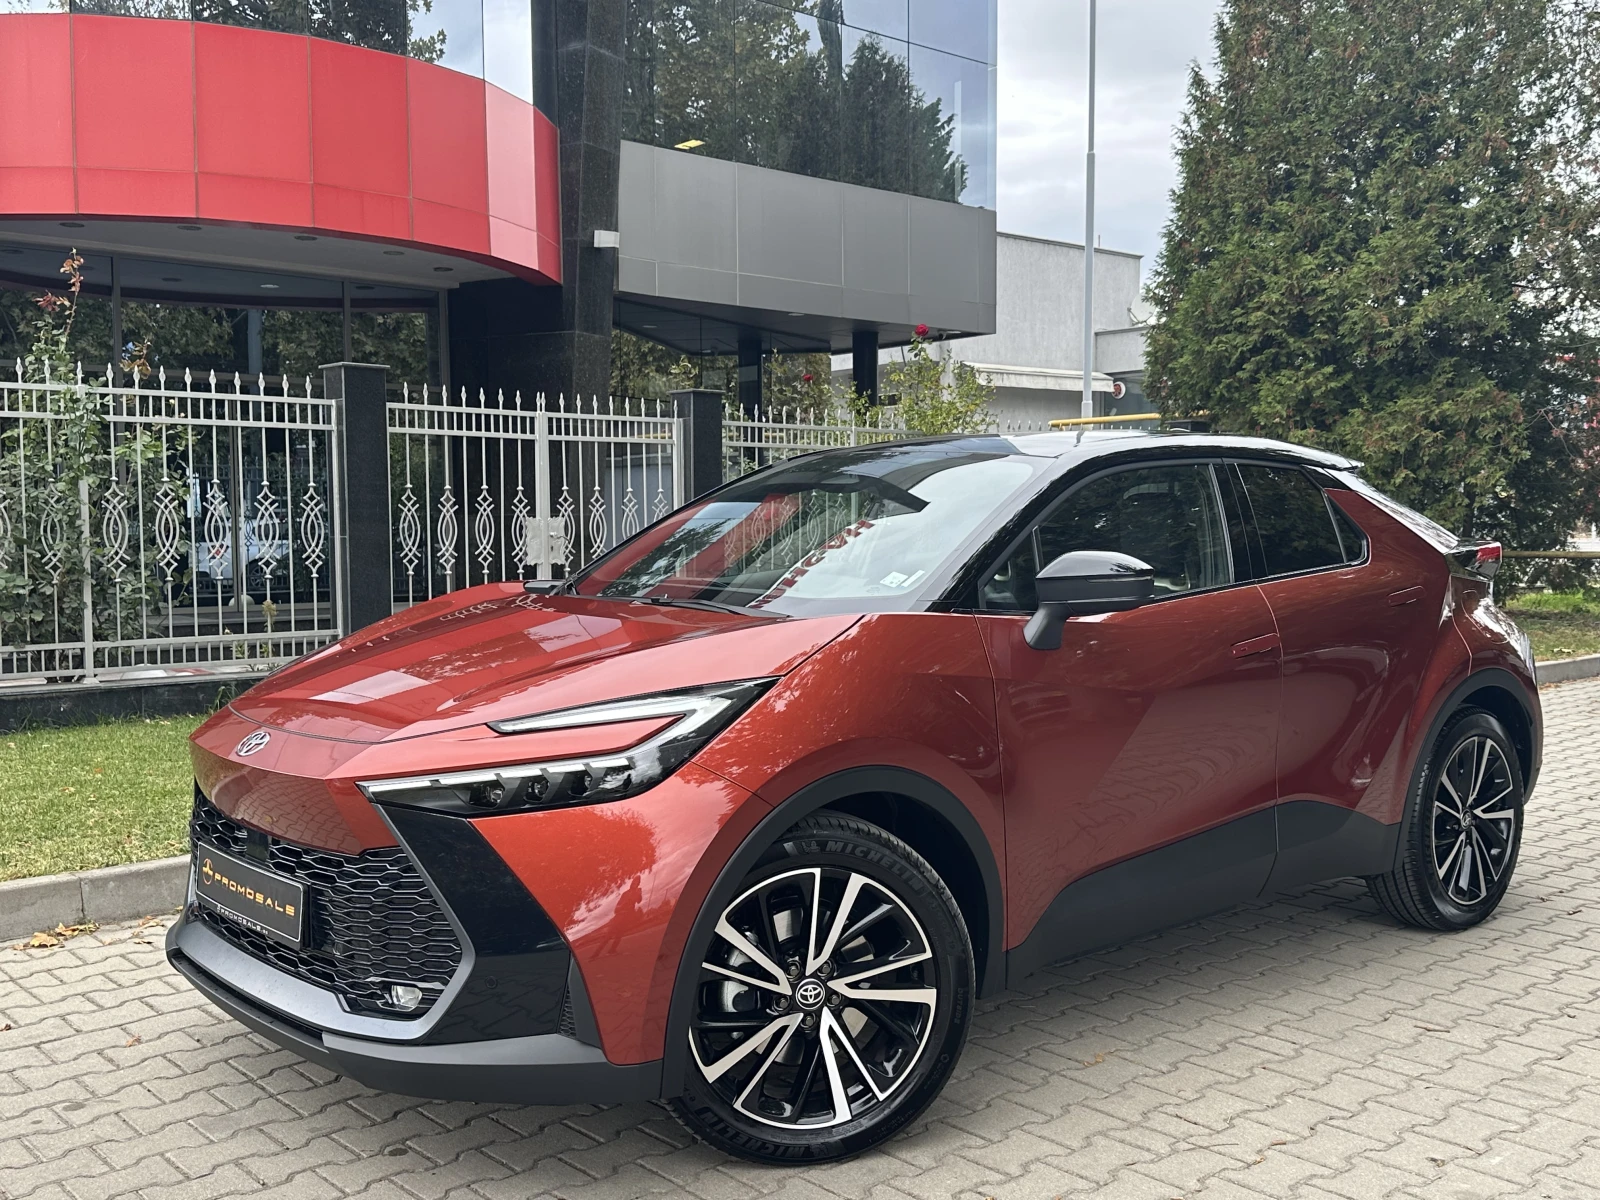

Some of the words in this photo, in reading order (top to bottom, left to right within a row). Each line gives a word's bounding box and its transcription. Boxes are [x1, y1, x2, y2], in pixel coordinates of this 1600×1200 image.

[825, 841, 923, 890] MICHELIN
[214, 873, 295, 916] PROMOSALE
[700, 1107, 807, 1158] MICHELIN
